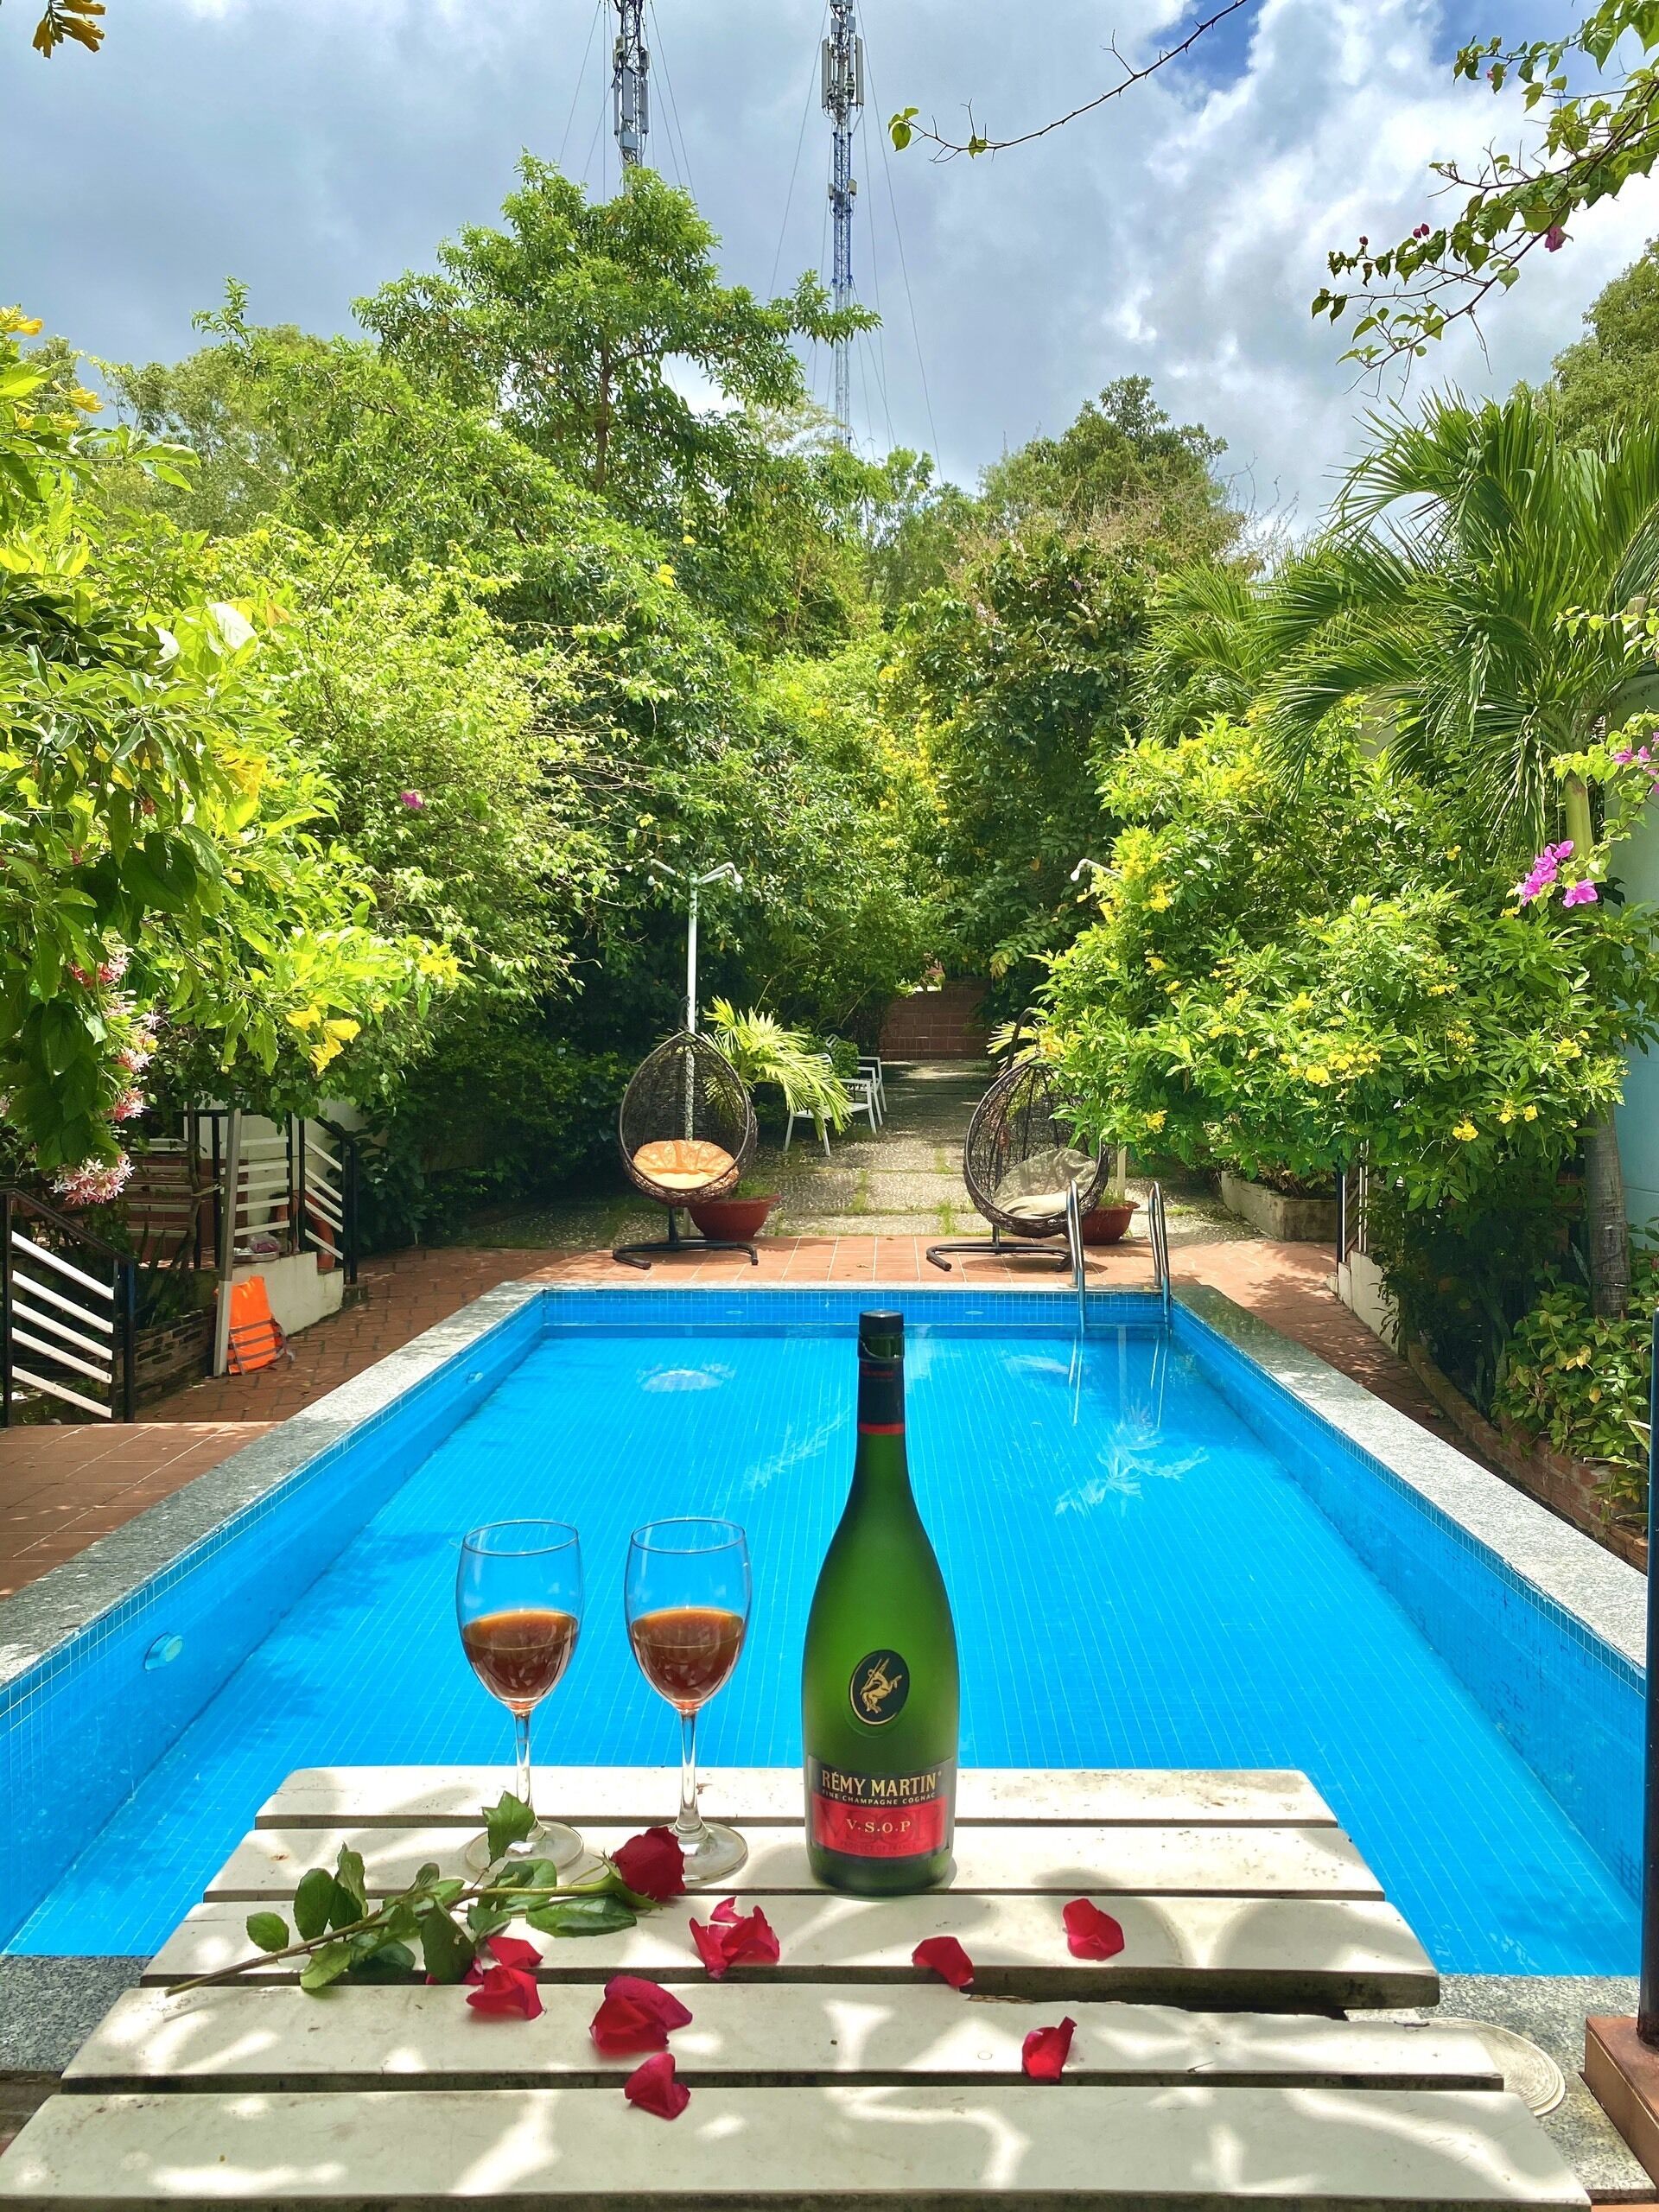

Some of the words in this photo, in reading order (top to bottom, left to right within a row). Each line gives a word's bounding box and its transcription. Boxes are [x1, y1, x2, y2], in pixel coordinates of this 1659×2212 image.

[822, 1770, 866, 1795] RÉMY
[871, 1772, 936, 1797] MARTIN
[823, 1789, 839, 1800] FINE
[842, 1795, 898, 1805] CHAMPAGNE
[902, 1792, 936, 1804] COGNAC
